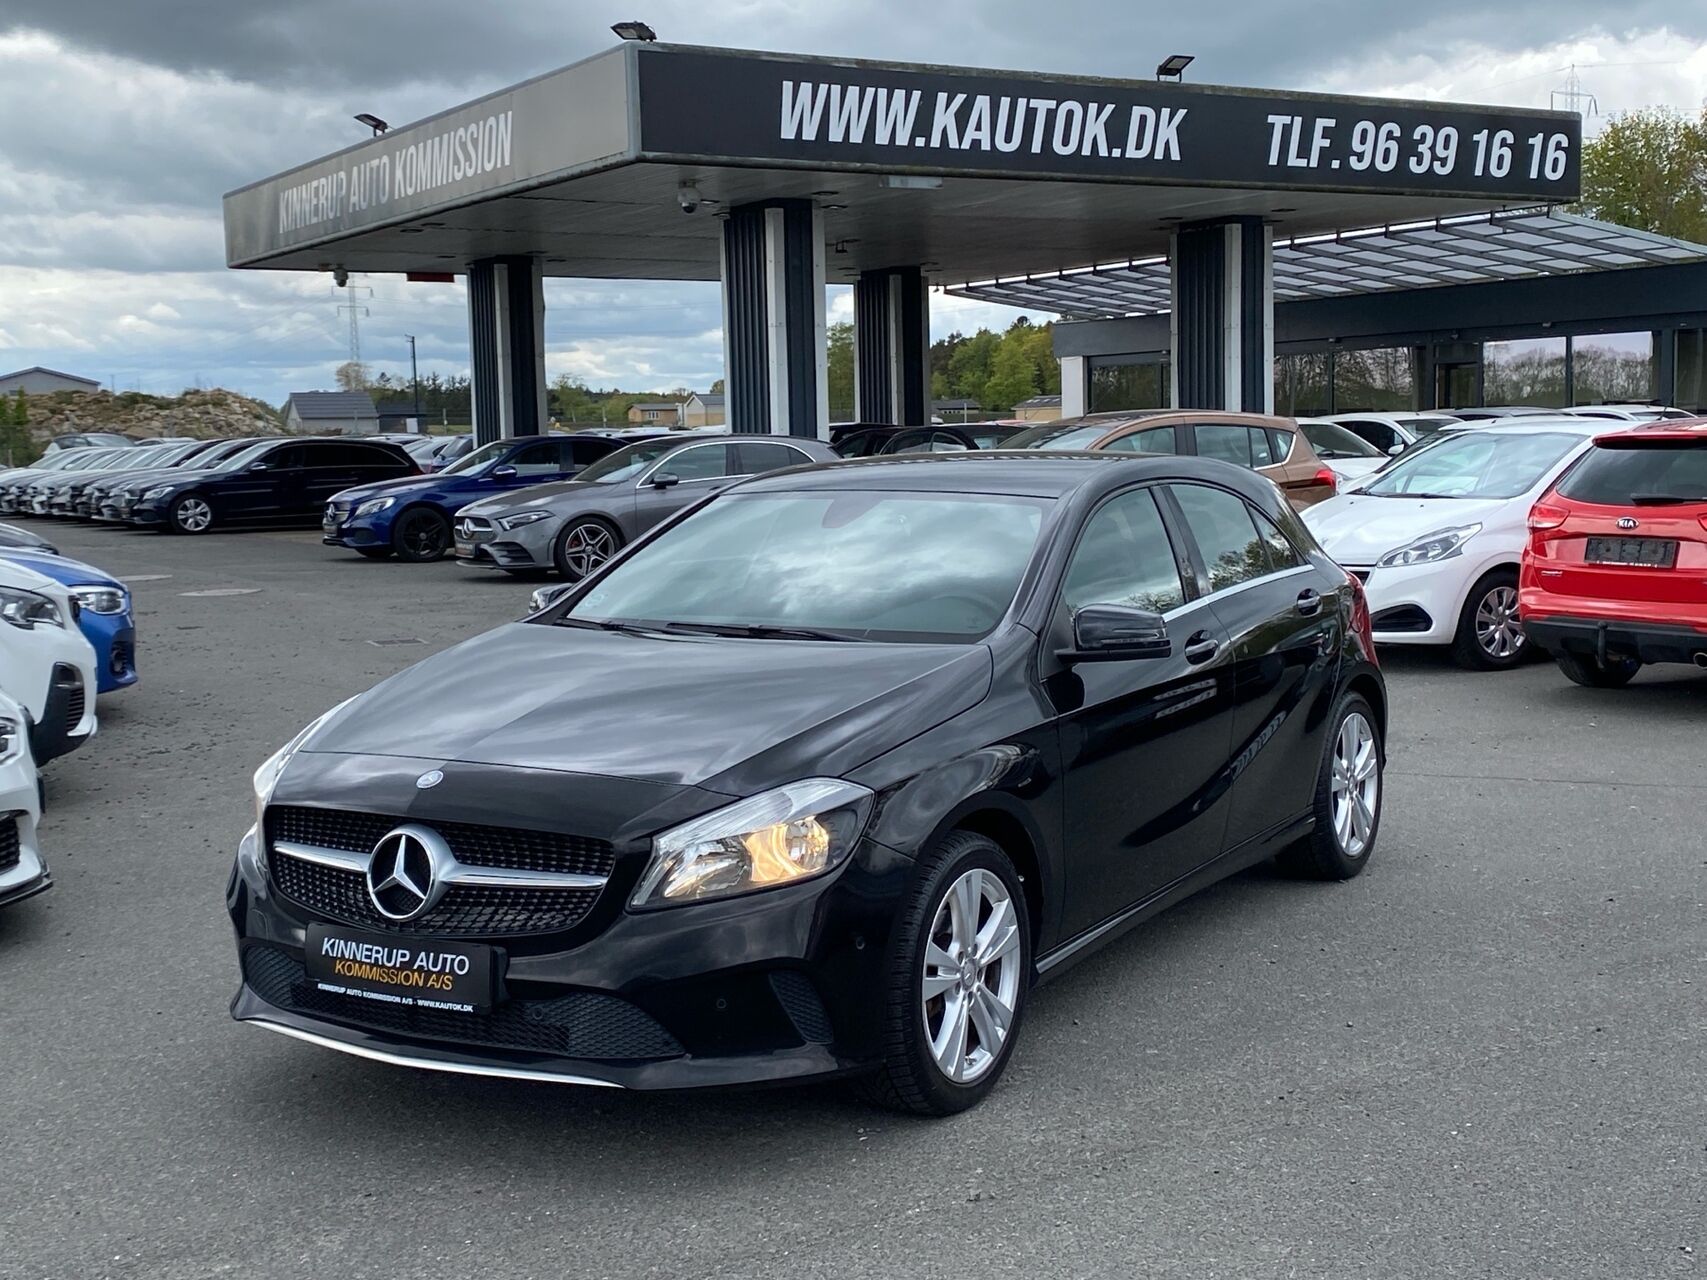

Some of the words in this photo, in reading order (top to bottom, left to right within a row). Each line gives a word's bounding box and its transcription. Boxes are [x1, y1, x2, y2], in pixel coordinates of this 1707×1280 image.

[780, 80, 1188, 161] WWW.KAUTOK.DK
[1267, 115, 1341, 169] TLF.
[1350, 120, 1401, 172] 96
[1409, 124, 1459, 175] 39
[1472, 129, 1515, 178] 16
[1528, 133, 1569, 181] 16
[279, 171, 347, 234] KINNERUP
[350, 155, 390, 213] AUTO
[394, 111, 513, 199] KOMMISSION
[1618, 519, 1634, 528] KIA
[322, 937, 410, 968] KINNERUP
[413, 951, 470, 975] AUTO
[335, 960, 424, 987] KOMMISSION
[427, 973, 453, 990] A/S
[346, 988, 362, 997] AUTO
[363, 991, 401, 1003] KOMMISSION
